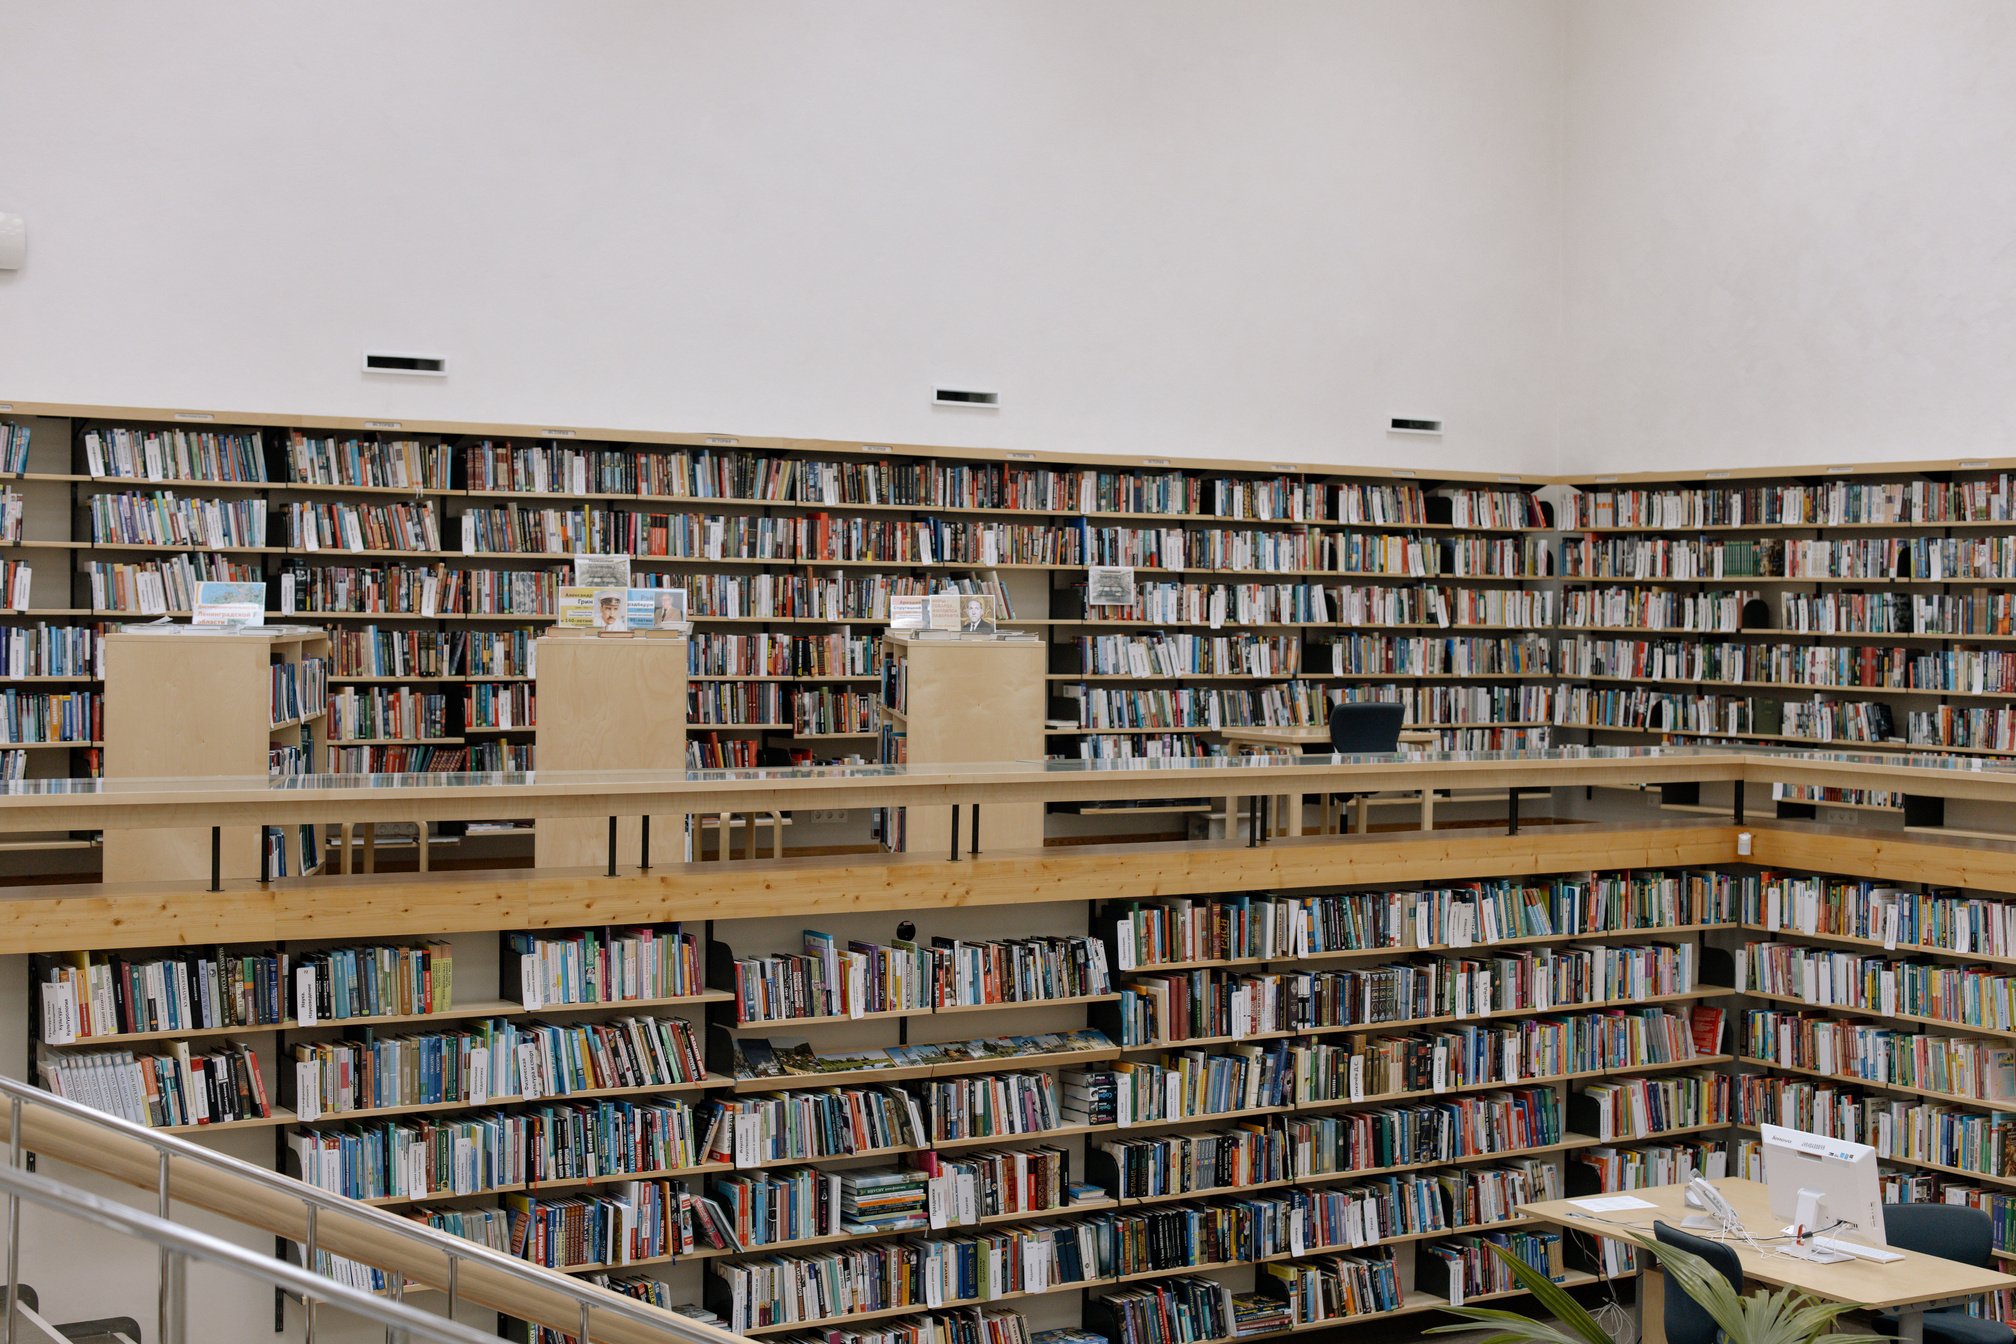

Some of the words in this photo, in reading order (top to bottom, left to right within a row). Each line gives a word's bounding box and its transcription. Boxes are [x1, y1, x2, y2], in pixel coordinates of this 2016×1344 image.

[180, 968, 188, 1008] КУЛЬТУРОЛОГИЯ
[63, 998, 71, 1037] Культурология
[521, 1058, 529, 1091] Физическая
[686, 1047, 697, 1070] MANAGER
[530, 1070, 539, 1097] культура
[628, 1133, 636, 1170] ПЛАВАНИЕ
